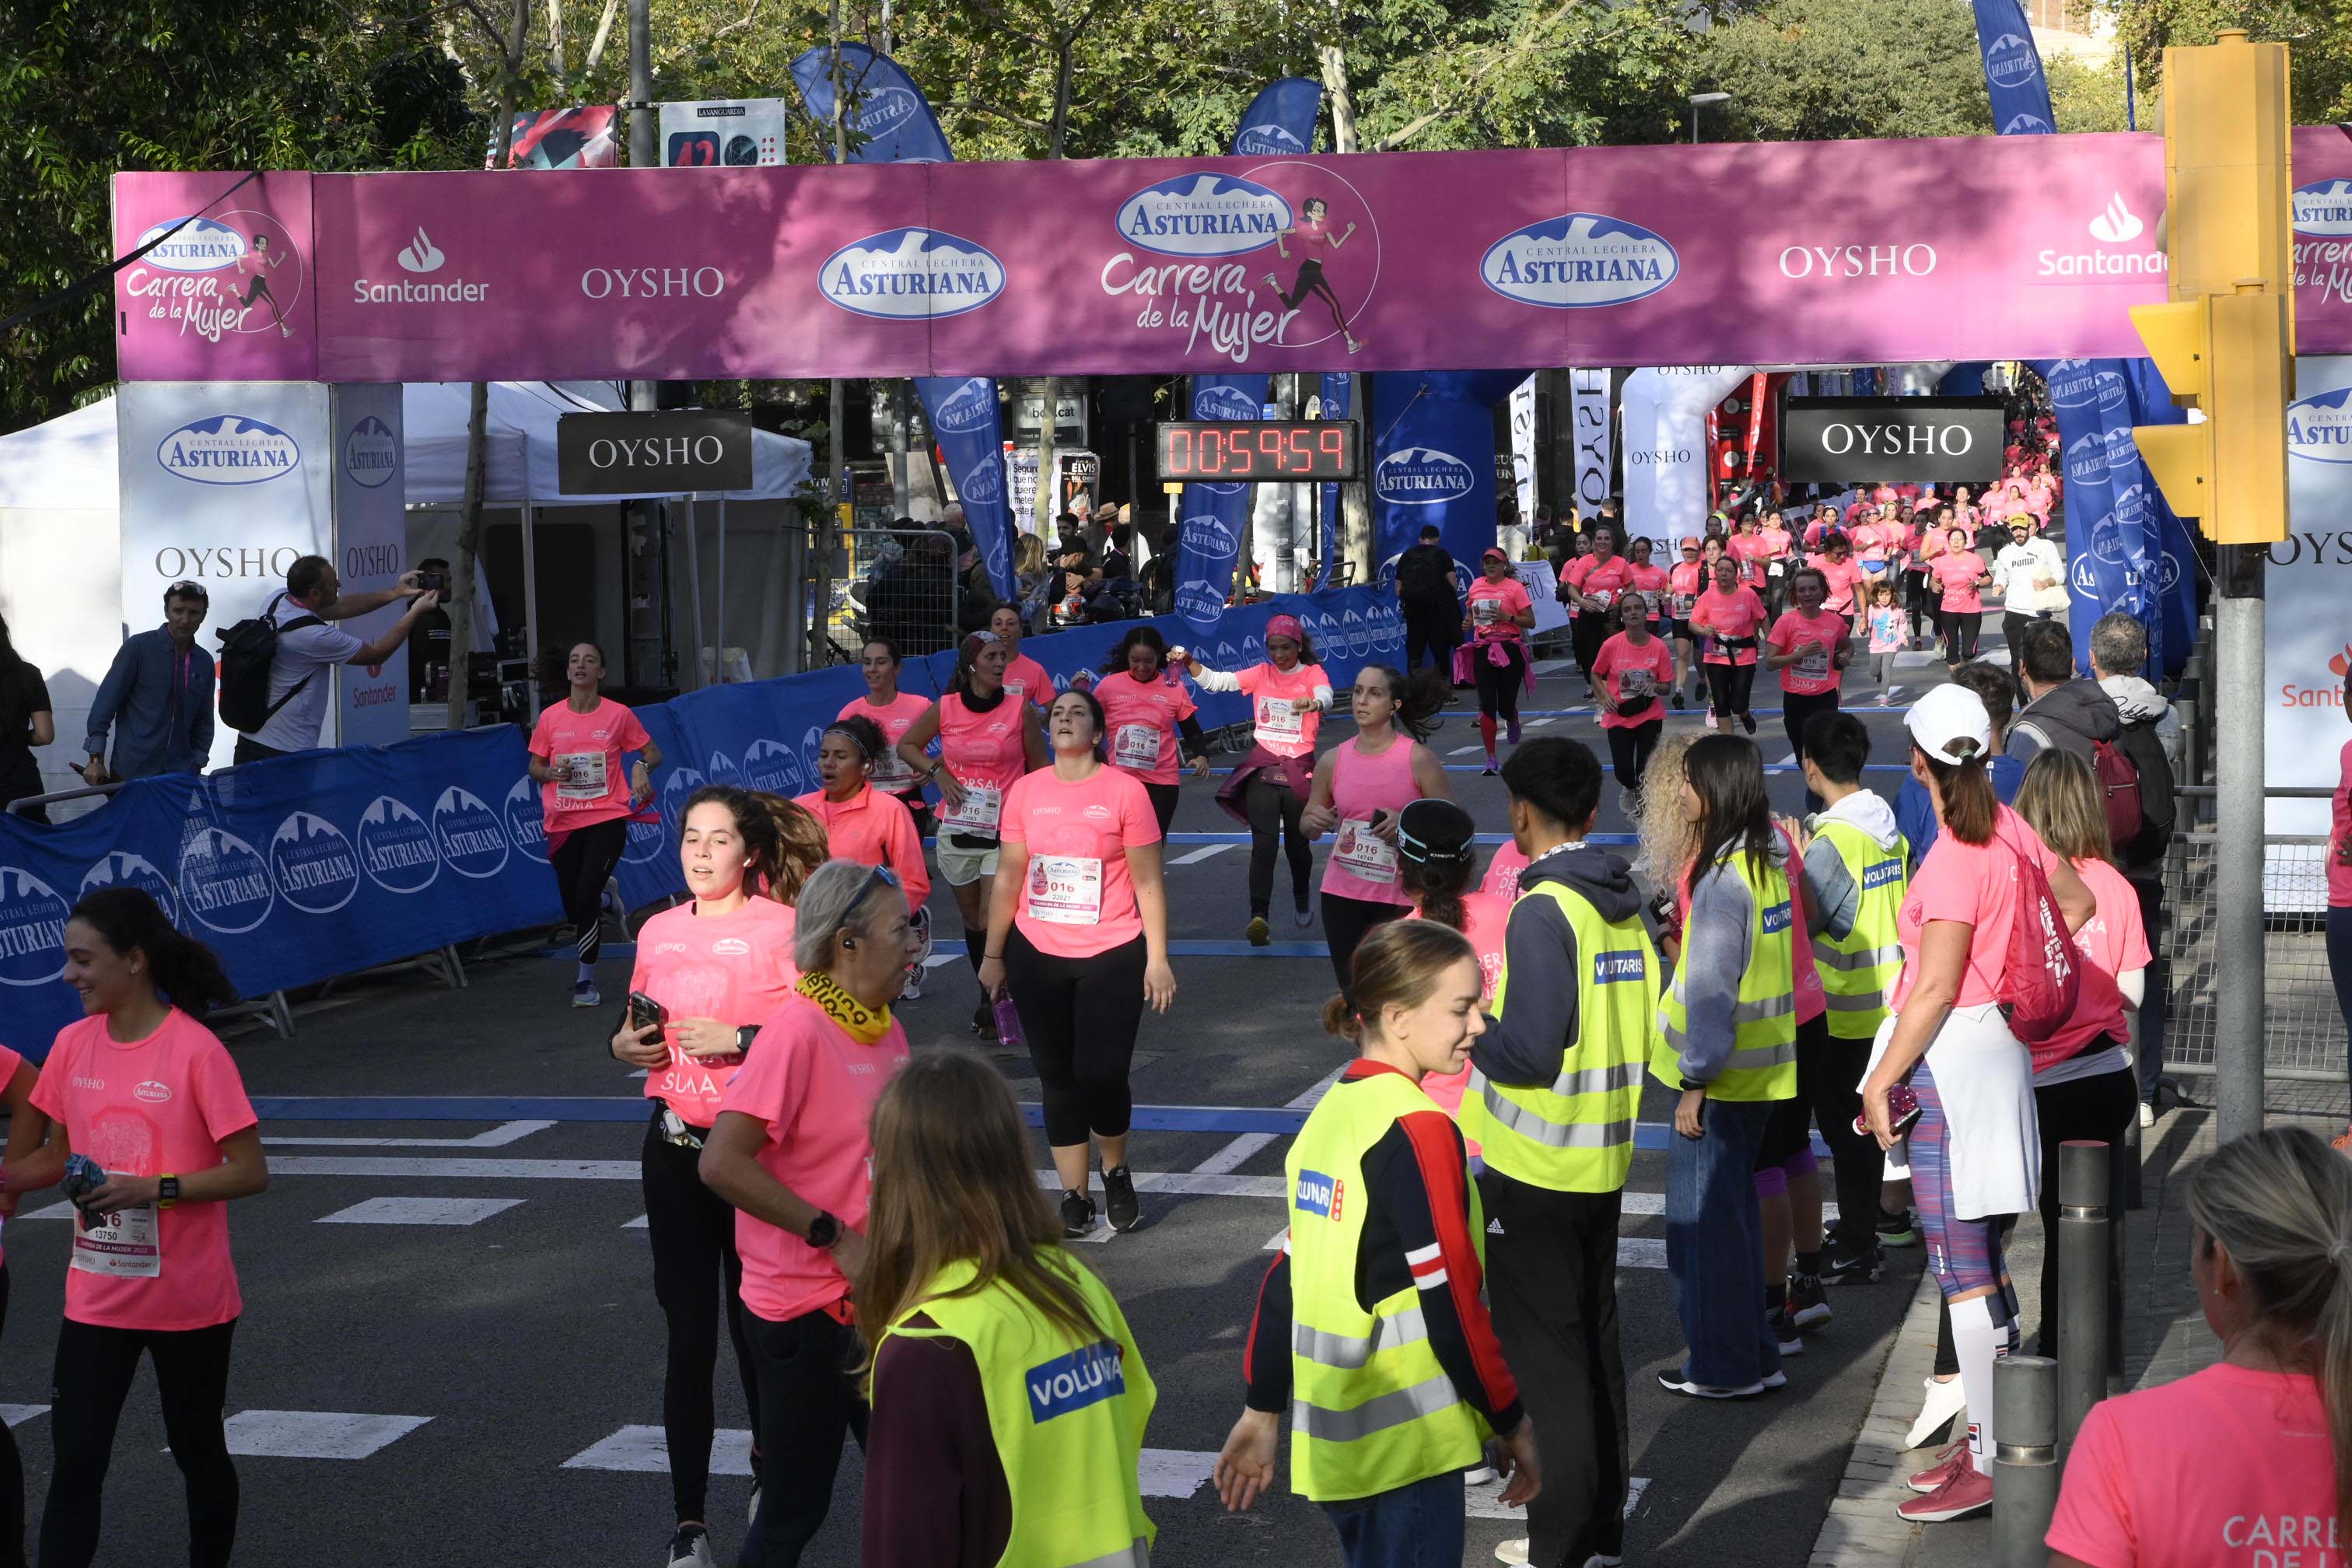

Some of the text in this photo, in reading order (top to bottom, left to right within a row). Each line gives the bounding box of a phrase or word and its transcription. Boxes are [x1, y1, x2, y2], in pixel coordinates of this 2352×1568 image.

[1217, 201, 1274, 209] LECHERA
[1129, 205, 1279, 236] ASTURIANA
[861, 258, 985, 268] CENTRAL LECHERA
[1526, 243, 1657, 256] CENTRAL LECHERA
[1779, 243, 1937, 278] OYSHO
[2294, 242, 2352, 264] arrer
[832, 262, 991, 296] ASTURIANA
[1101, 253, 1247, 296] Carrera
[1496, 250, 1663, 284] ASTURIANA
[2311, 265, 2325, 285] la
[126, 268, 218, 297] Carrera
[354, 278, 489, 303] Santander
[581, 267, 724, 298] OYSHO
[149, 296, 182, 318] de la
[180, 296, 253, 342] Mujer
[1136, 298, 1188, 328] de la
[1185, 291, 1301, 363] Mujer
[1576, 368, 1605, 506] OYSH
[1822, 423, 1972, 456] OYSHO
[169, 441, 289, 467] ASTURIANA
[349, 440, 394, 470] ASTURIANA
[589, 436, 724, 468] OYSHO
[1170, 429, 1343, 473] 00:59:59
[1632, 450, 1690, 464] OYSHO
[1014, 476, 1026, 486] que
[1072, 463, 1095, 473] ELVIS
[1379, 471, 1466, 491] ASTURIANA
[1031, 508, 1054, 516] po
[156, 547, 301, 578] OYSHO
[347, 544, 398, 578] OYSHO
[2011, 558, 2035, 568] PUMA
[1526, 572, 1544, 600] HO
[353, 683, 396, 710] Santander
[2281, 685, 2344, 707] Sant
[555, 798, 593, 809] SUMA
[1033, 807, 1061, 815] OYSHO
[439, 823, 506, 858] ASTURIANA
[512, 811, 548, 845] ASTU
[366, 835, 436, 873] ASTURIANA
[1356, 843, 1377, 854] 016
[278, 854, 356, 894] ASTURIANA
[1496, 864, 1518, 877] CAR
[190, 871, 270, 912] ASTURIANA
[1050, 882, 1074, 892] 016
[1500, 879, 1517, 891] DE
[0, 907, 26, 922] NTRAL
[1334, 1181, 1343, 1220] 2000
[95, 1230, 117, 1241] 13750
